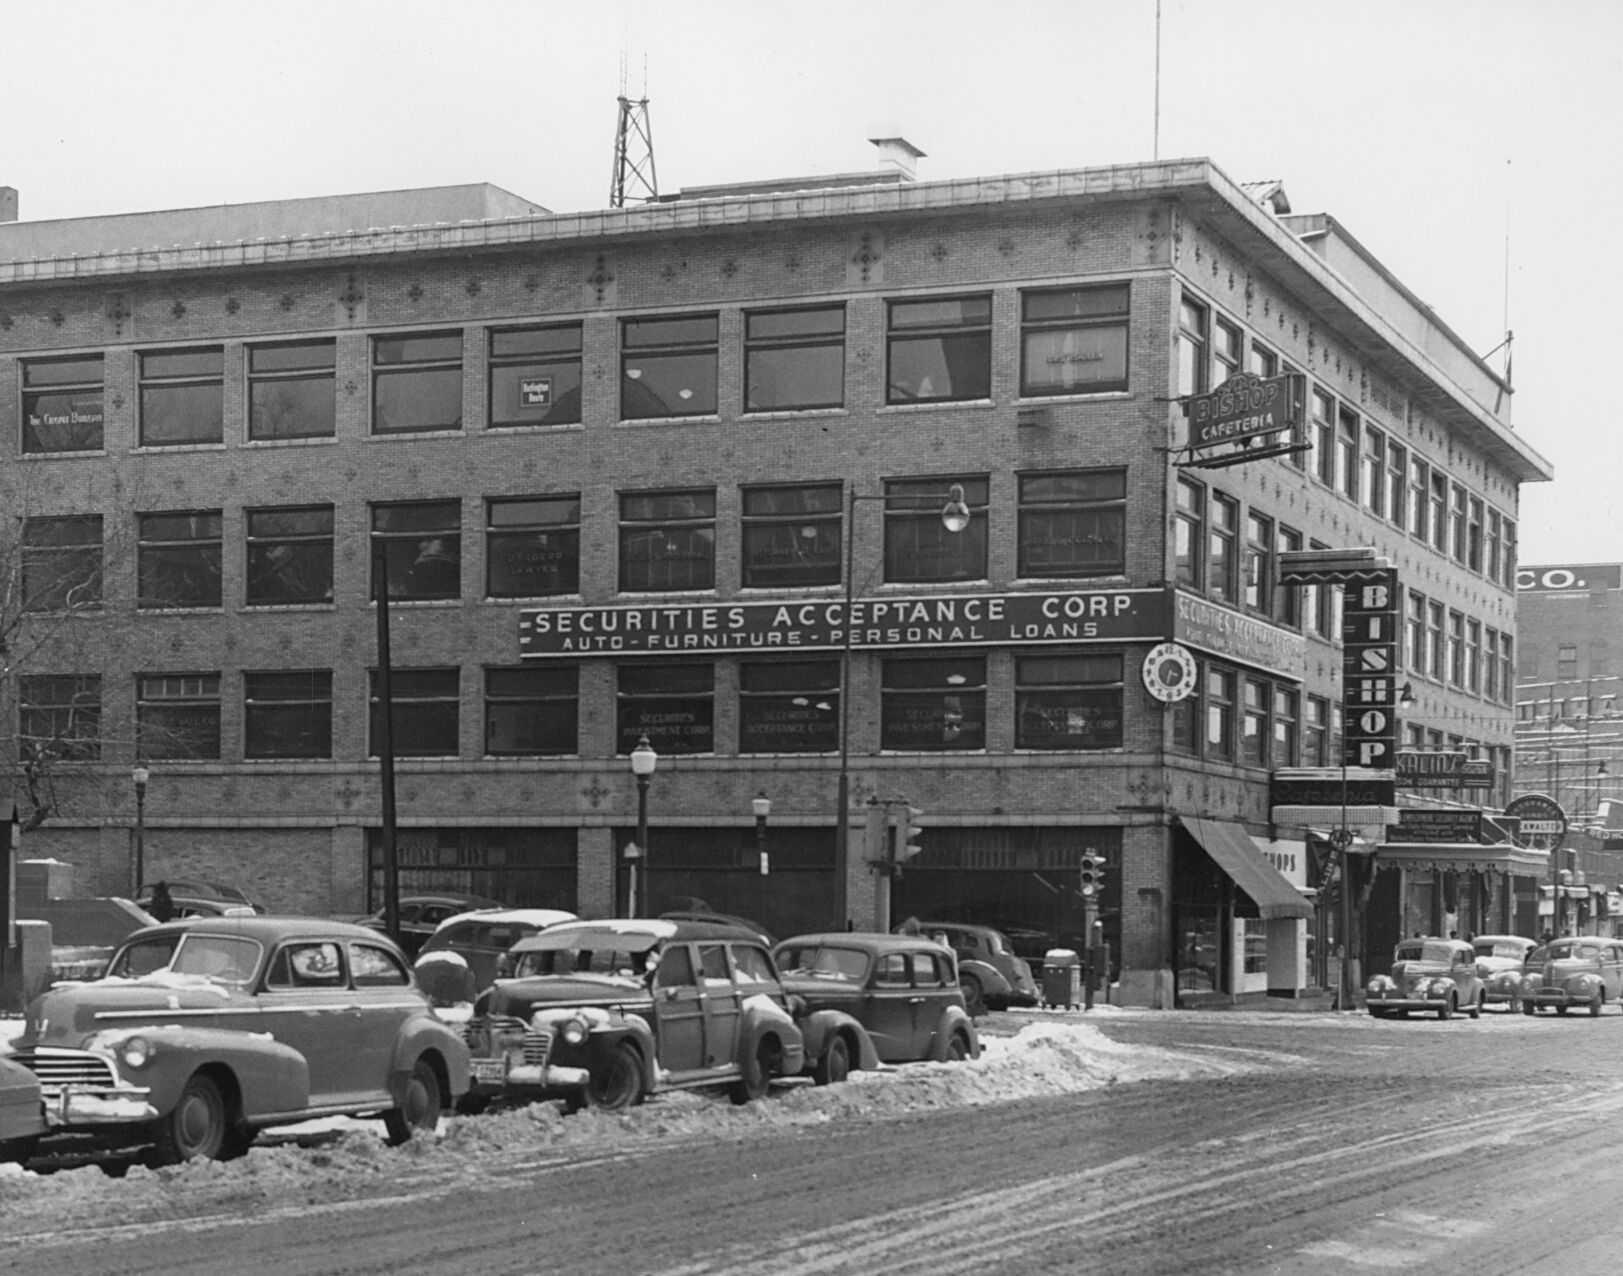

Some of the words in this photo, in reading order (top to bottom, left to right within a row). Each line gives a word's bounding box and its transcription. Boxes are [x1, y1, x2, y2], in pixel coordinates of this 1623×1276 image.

[1197, 383, 1279, 422] BISHOP
[1202, 412, 1275, 440] CAFETERIA
[1516, 569, 1587, 590] CO.
[535, 607, 745, 633] SECURITIES
[772, 598, 1006, 627] ACCEPTANCE
[1041, 595, 1138, 619] CORP.
[1009, 621, 1098, 640] LOANS
[1360, 585, 1389, 765] BISHOP
